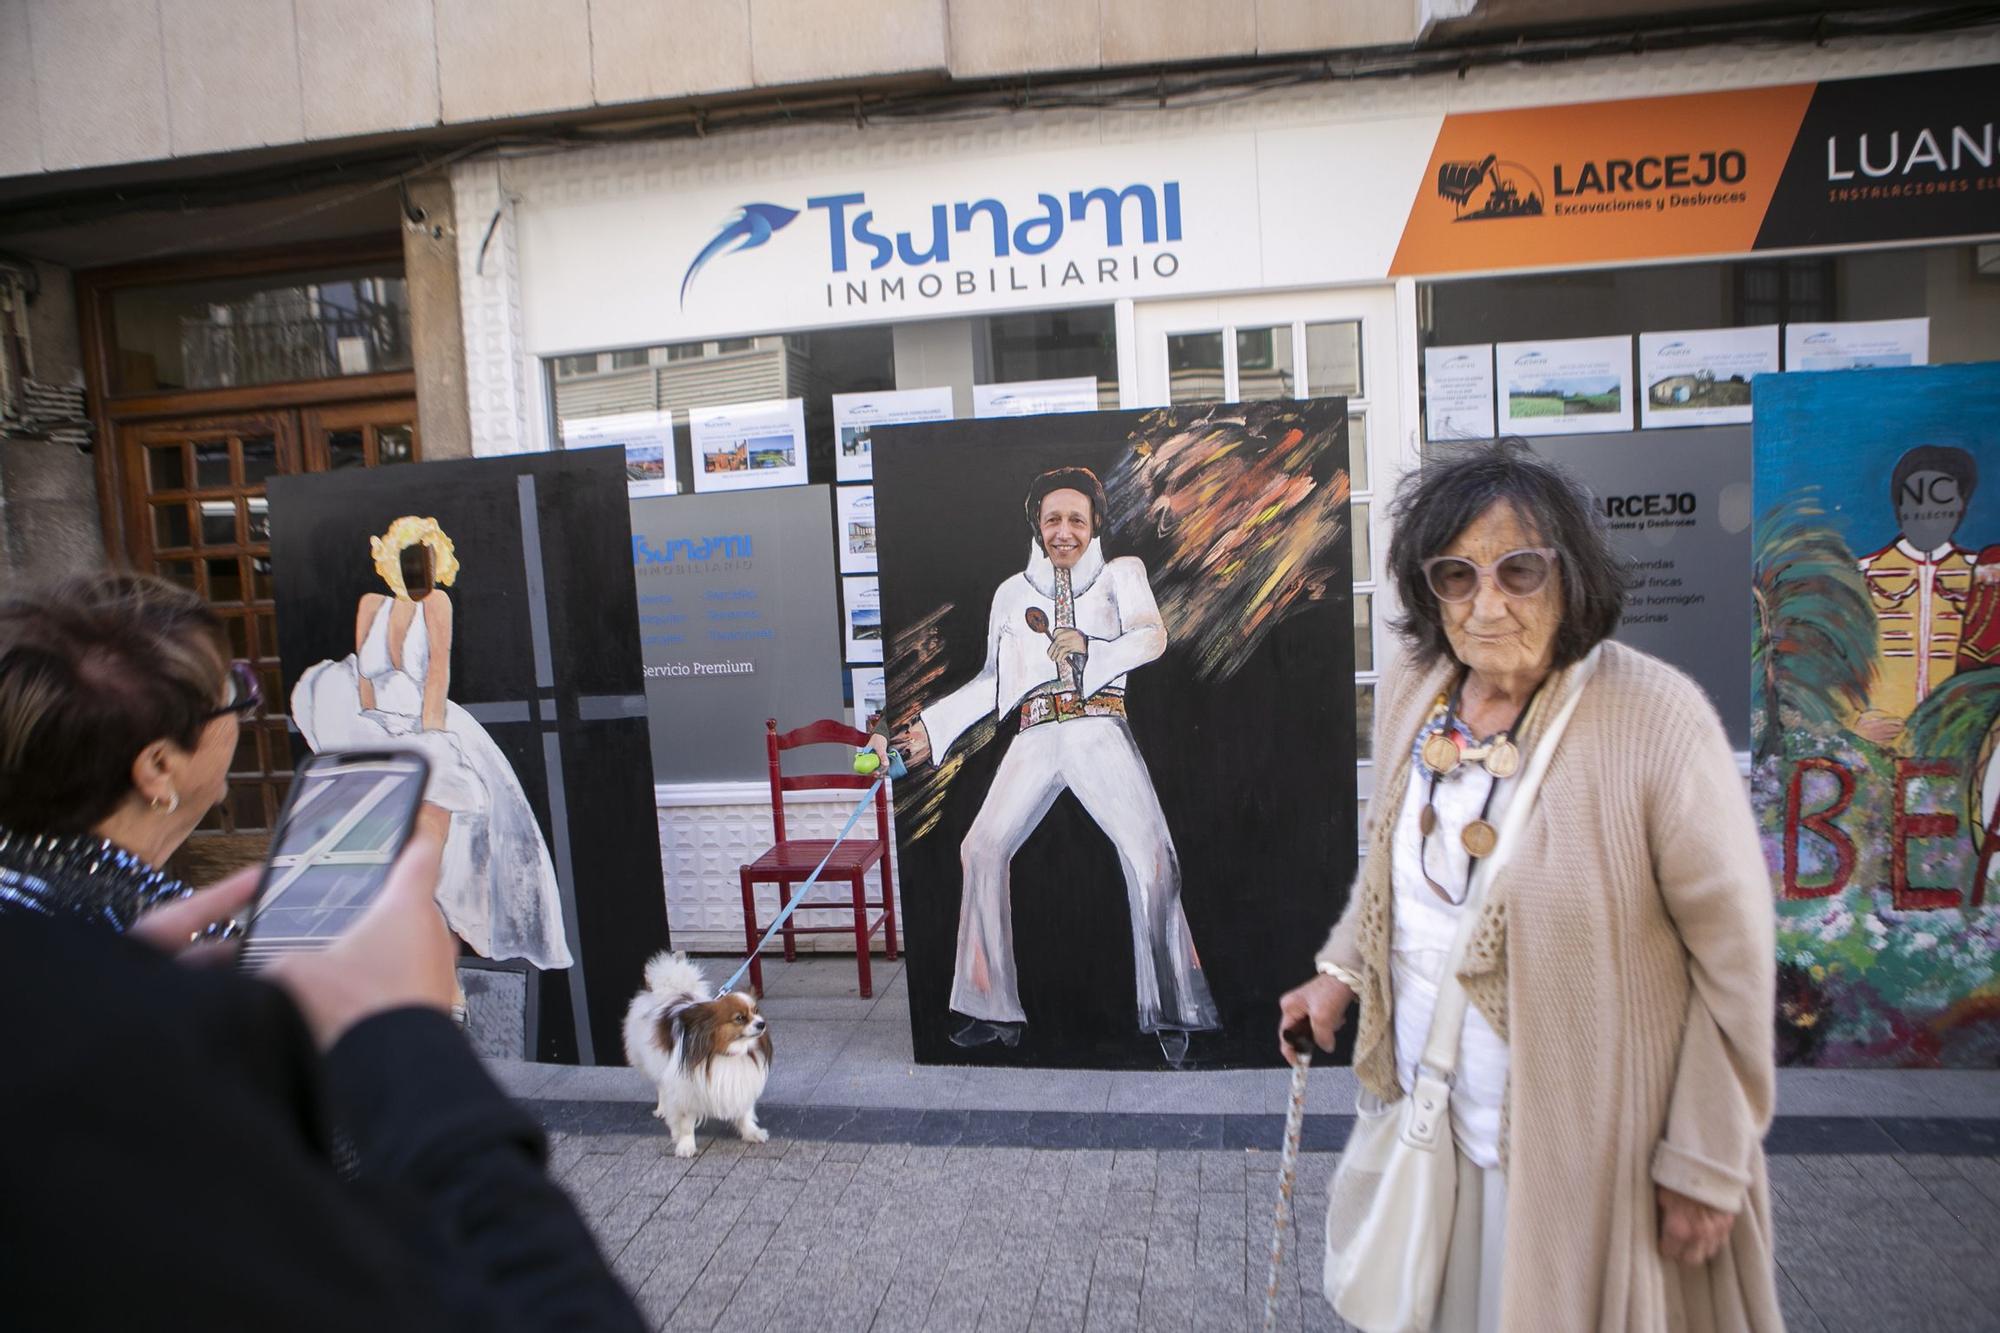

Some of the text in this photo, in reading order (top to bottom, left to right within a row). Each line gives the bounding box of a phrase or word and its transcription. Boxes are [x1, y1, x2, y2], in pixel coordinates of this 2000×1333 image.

[1827, 123, 2000, 181] LUAN
[1553, 150, 1747, 197] LARCEJO
[1555, 191, 1747, 216] Excavaciones y Desbroces
[1828, 179, 1969, 203] INSTALACIONES
[806, 181, 1183, 272] Tsunami
[826, 252, 1180, 307] INMOBILIARIO
[1597, 492, 1697, 517] RCEJO
[1622, 612, 1669, 626] piscinas
[692, 660, 754, 675] Premium
